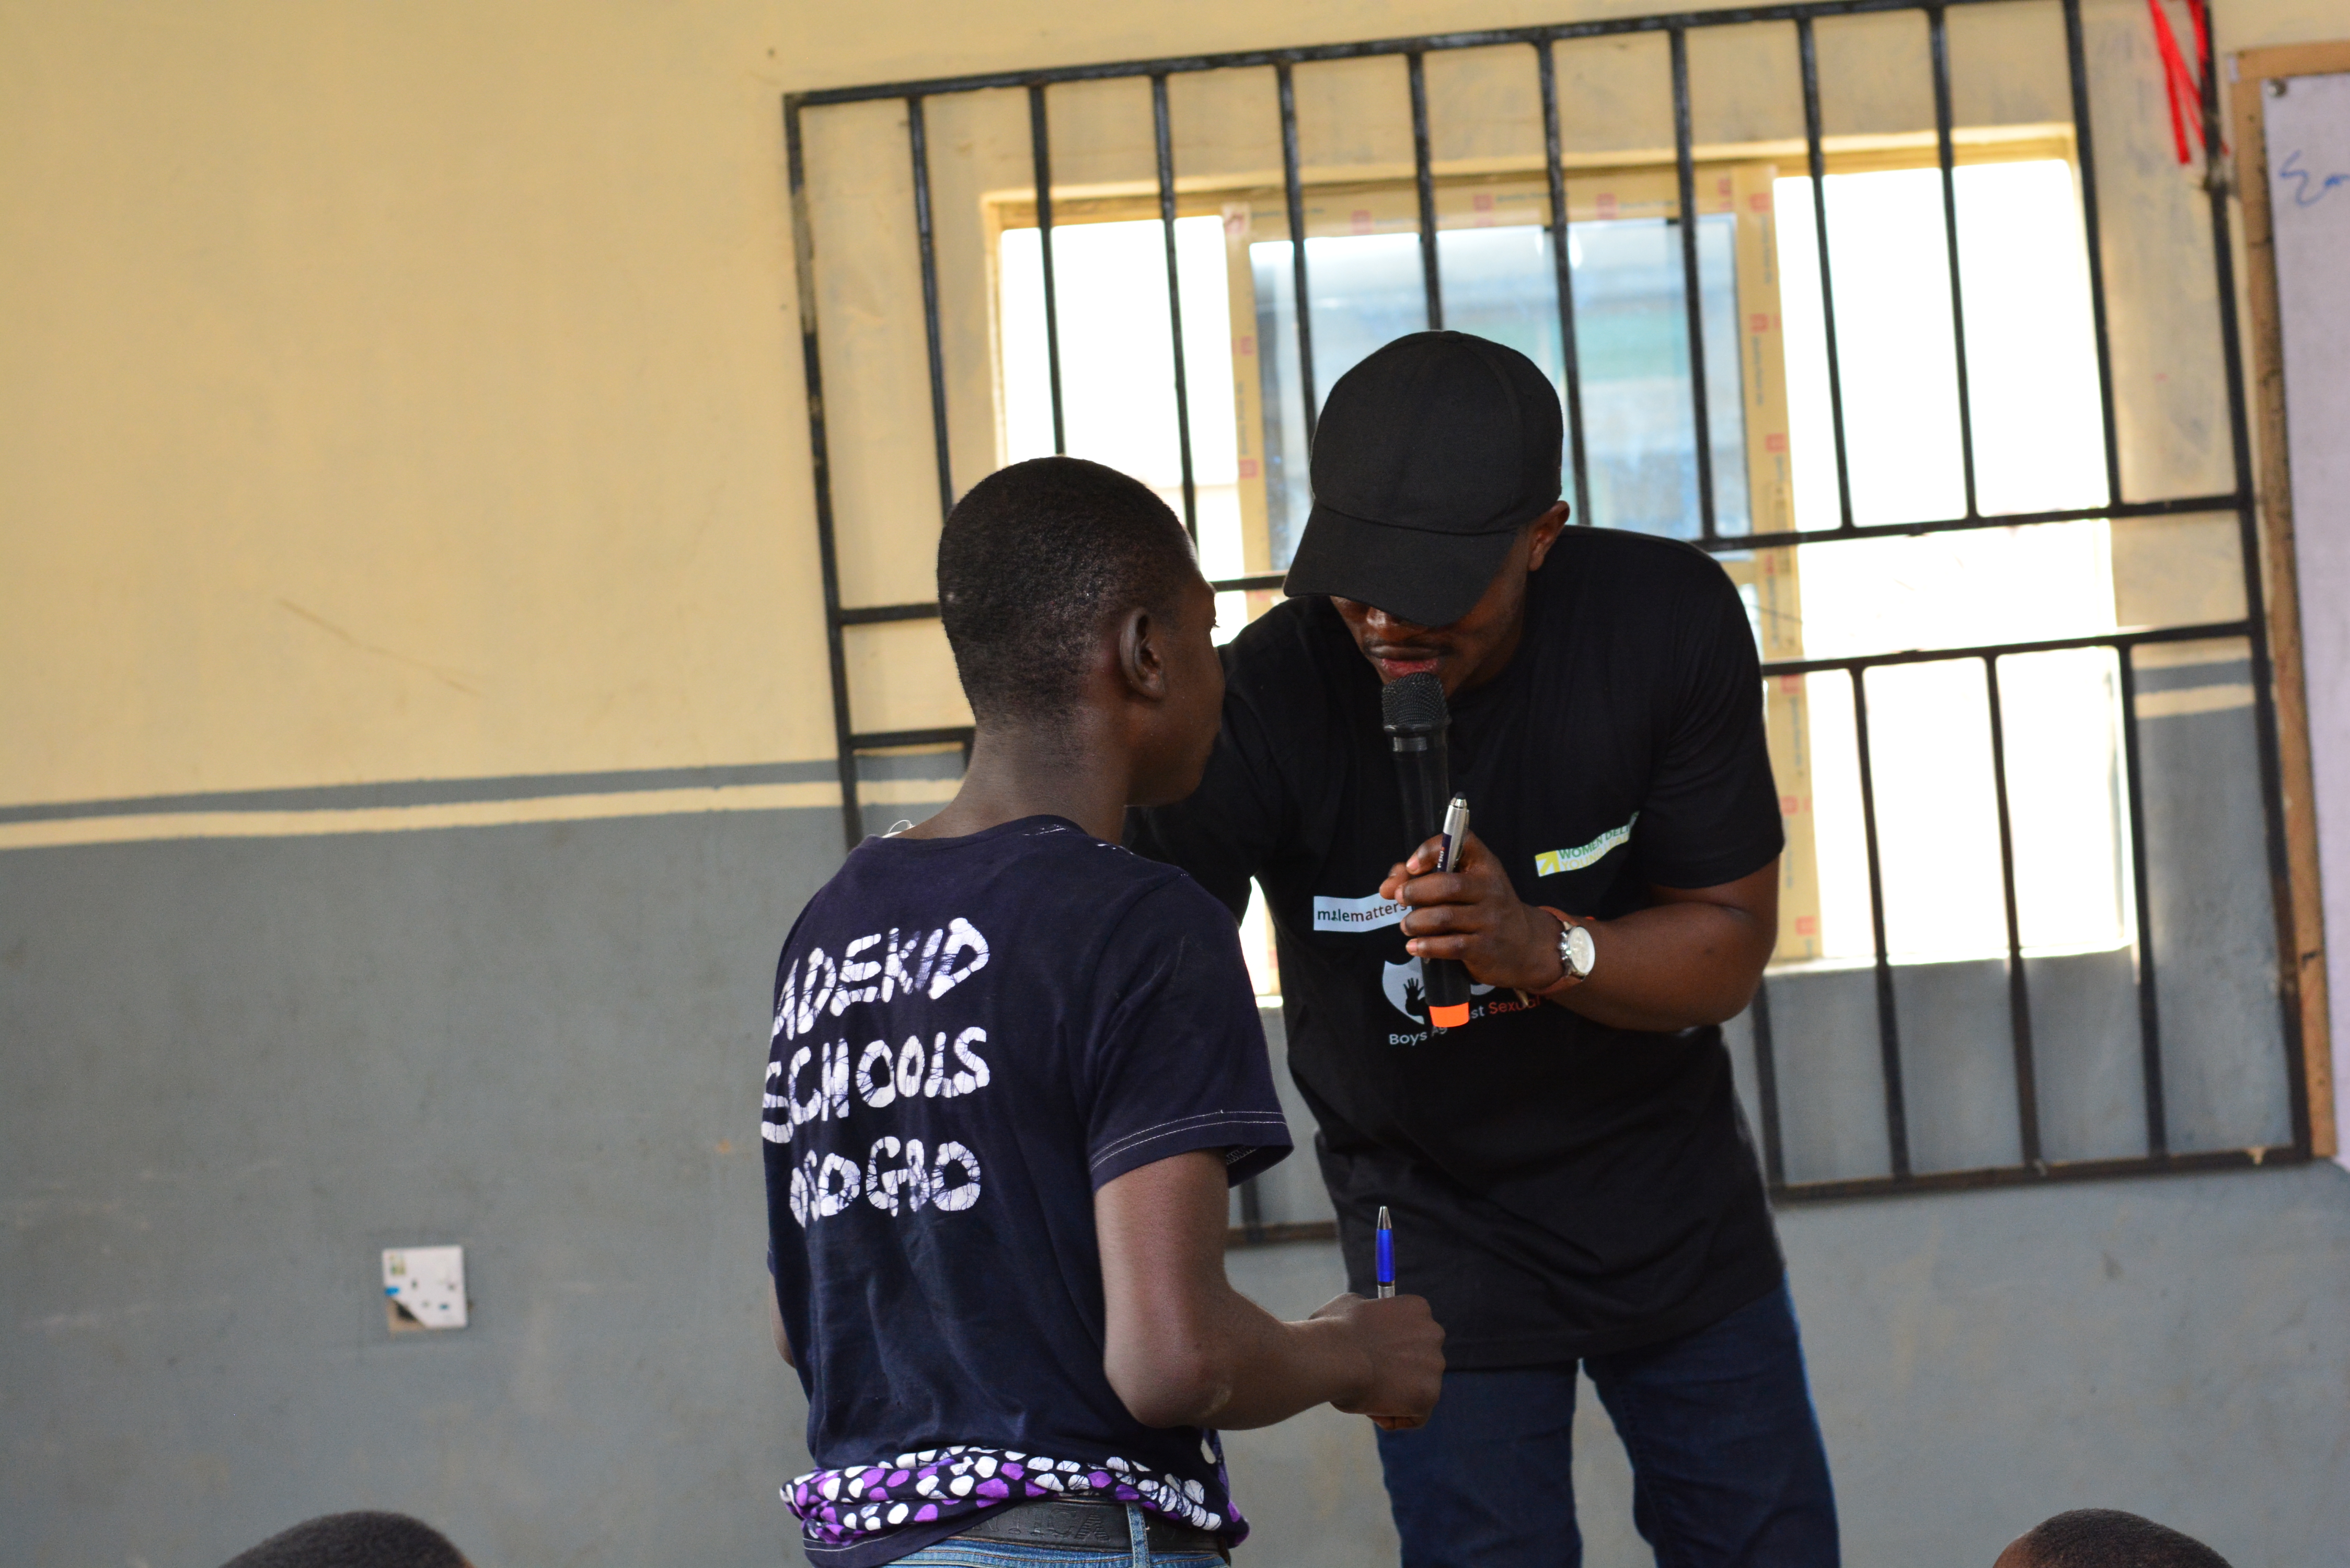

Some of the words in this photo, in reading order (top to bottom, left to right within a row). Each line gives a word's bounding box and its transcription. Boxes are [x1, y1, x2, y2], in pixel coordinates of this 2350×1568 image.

[1558, 837, 1603, 859] WOMEN
[1604, 824, 1630, 840] DELI
[1389, 1031, 1427, 1046] Boys
[1431, 1005, 1484, 1037] Agst
[761, 1027, 990, 1144] SCHOOLS
